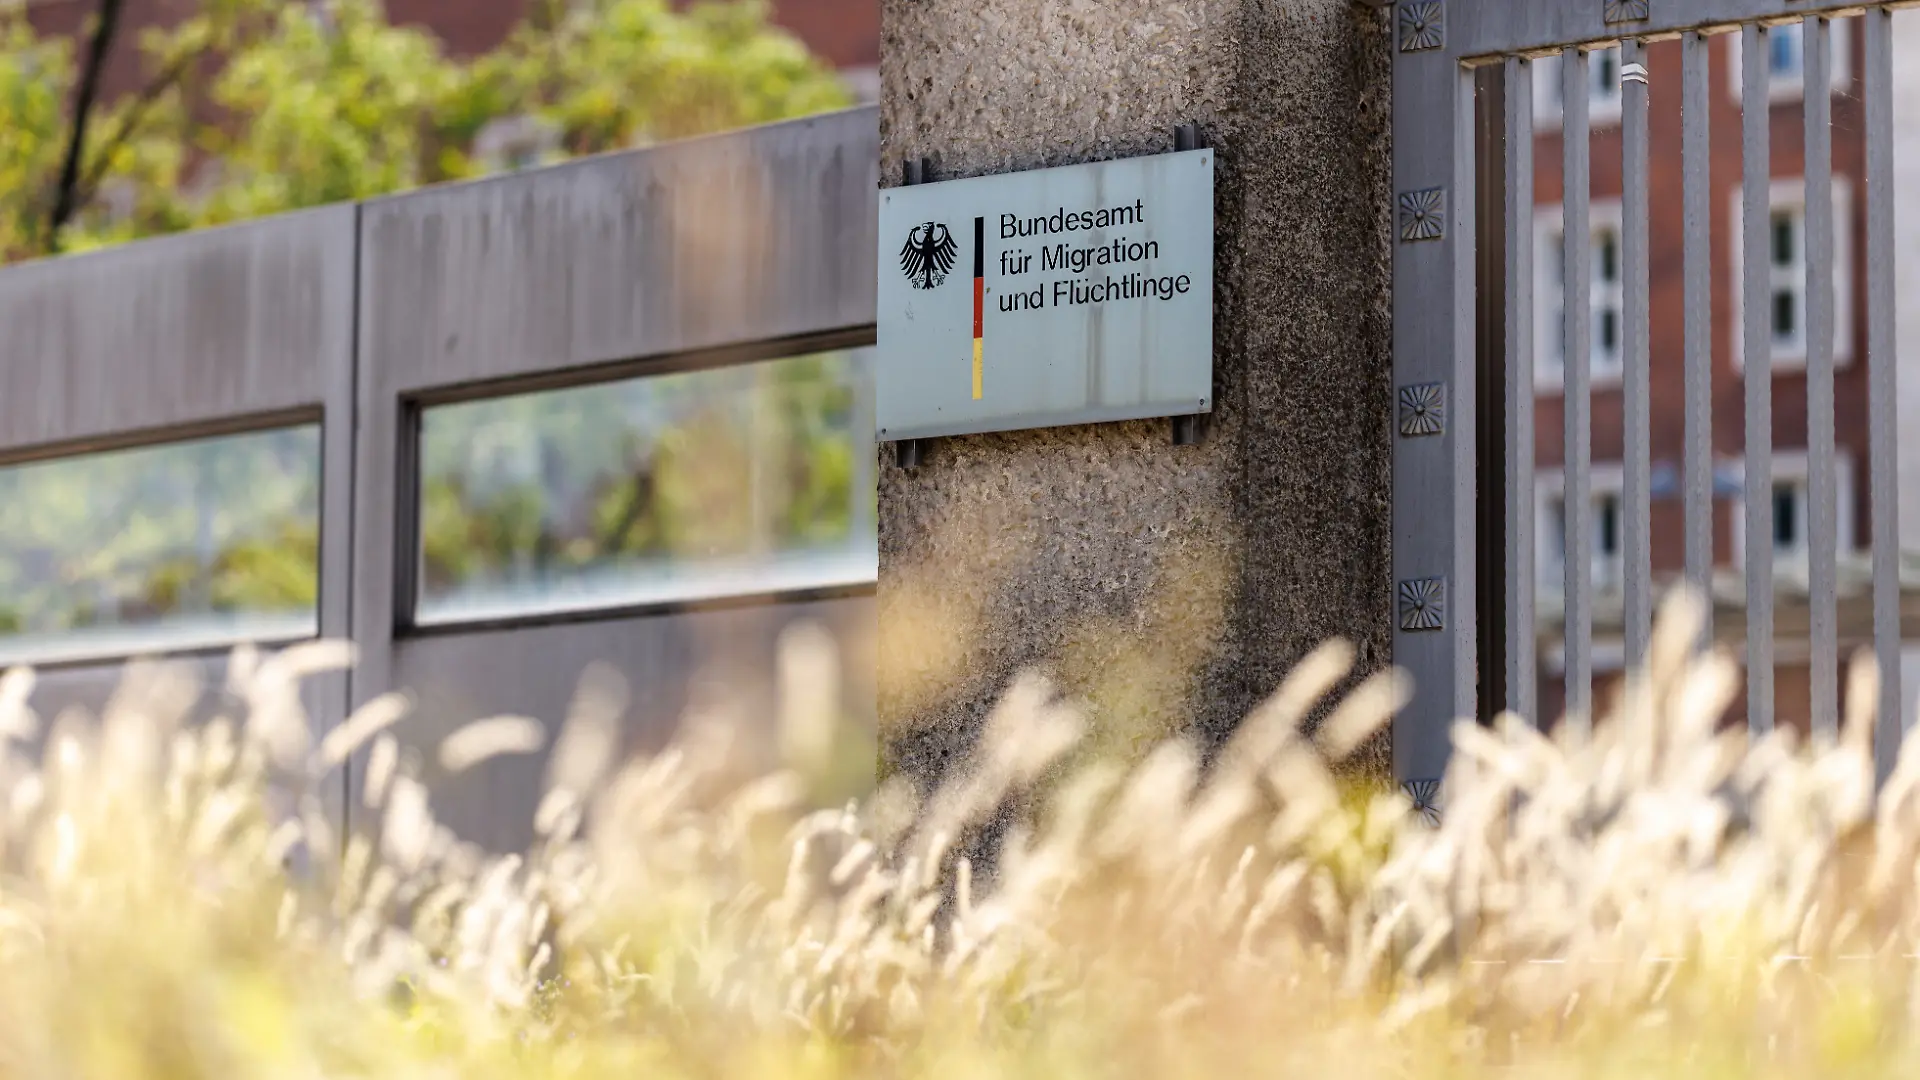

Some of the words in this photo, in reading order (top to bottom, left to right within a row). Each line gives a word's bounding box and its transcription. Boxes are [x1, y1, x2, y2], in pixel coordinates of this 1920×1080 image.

[1000, 199, 1144, 240] Bundesamt
[999, 248, 1033, 276] für
[1041, 236, 1159, 274] Migration
[999, 282, 1044, 312] und
[1053, 272, 1191, 307] Flüchtlinge
